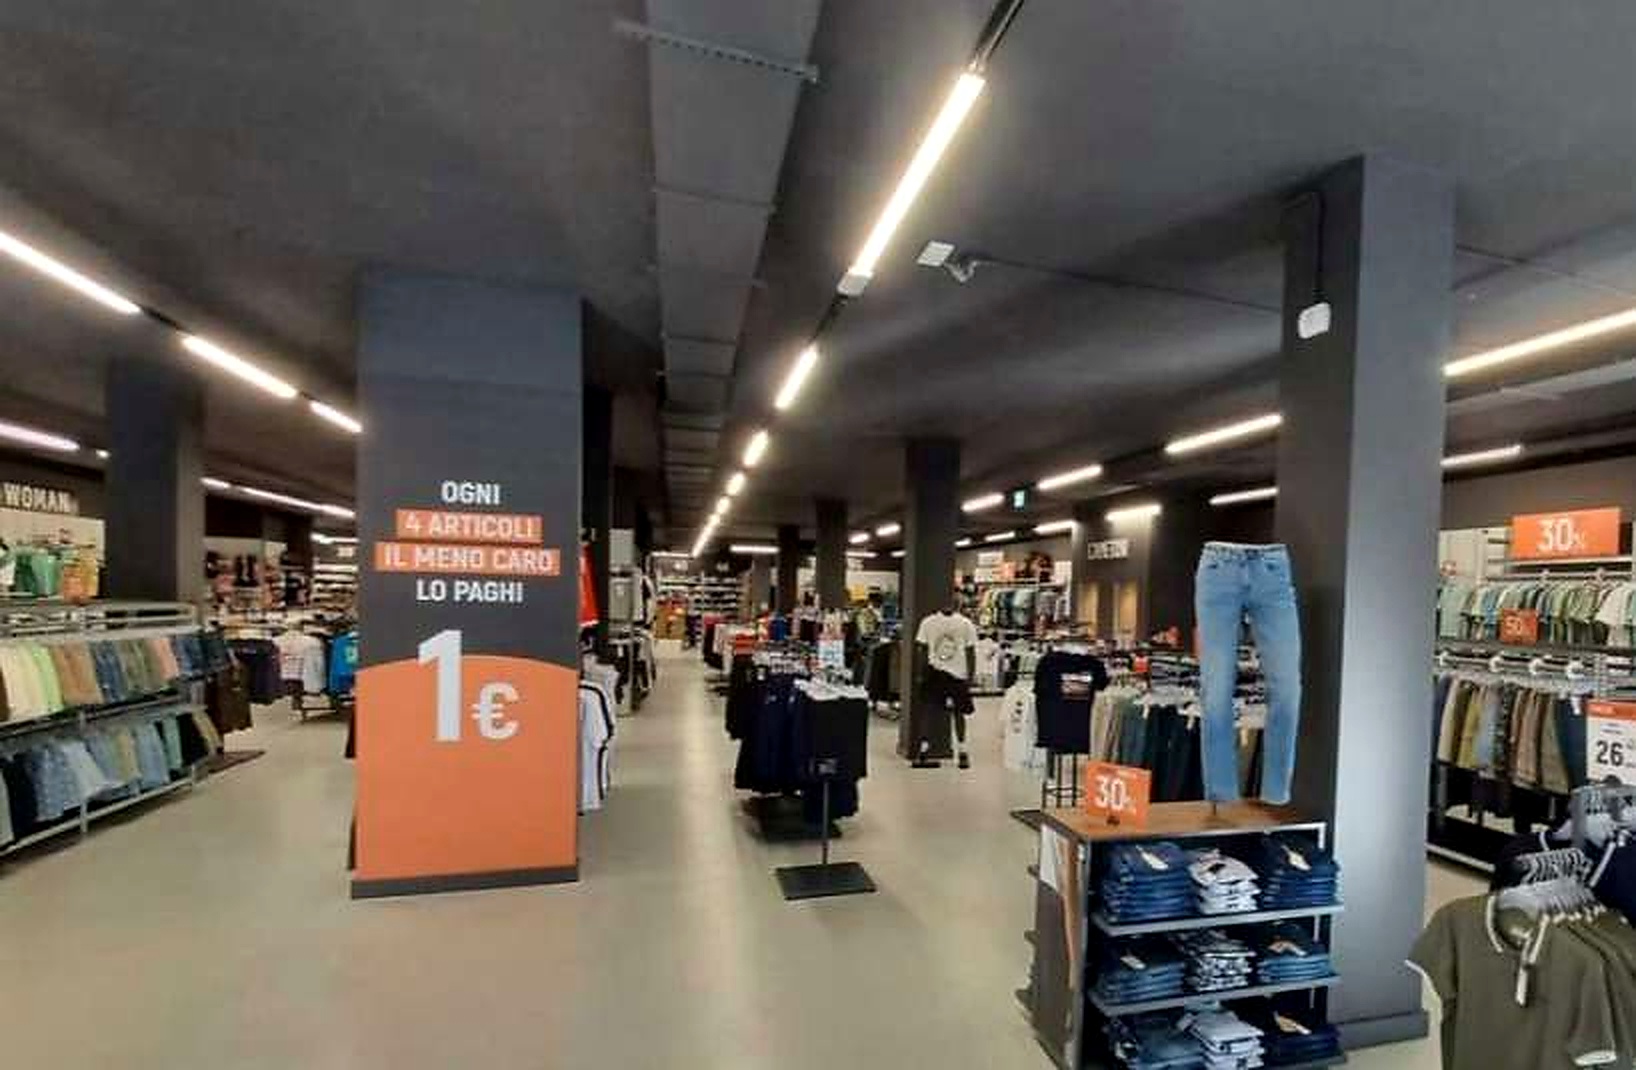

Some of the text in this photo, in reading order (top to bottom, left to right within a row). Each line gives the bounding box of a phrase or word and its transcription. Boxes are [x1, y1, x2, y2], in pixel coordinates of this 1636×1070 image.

[3, 482, 71, 513] WOMAN
[441, 481, 501, 505] OGNI
[405, 512, 533, 538] 4 ARTICOLI
[384, 544, 553, 572] IL MENO CARO
[416, 580, 524, 603] LO PAGHI
[1596, 740, 1624, 767] 26
